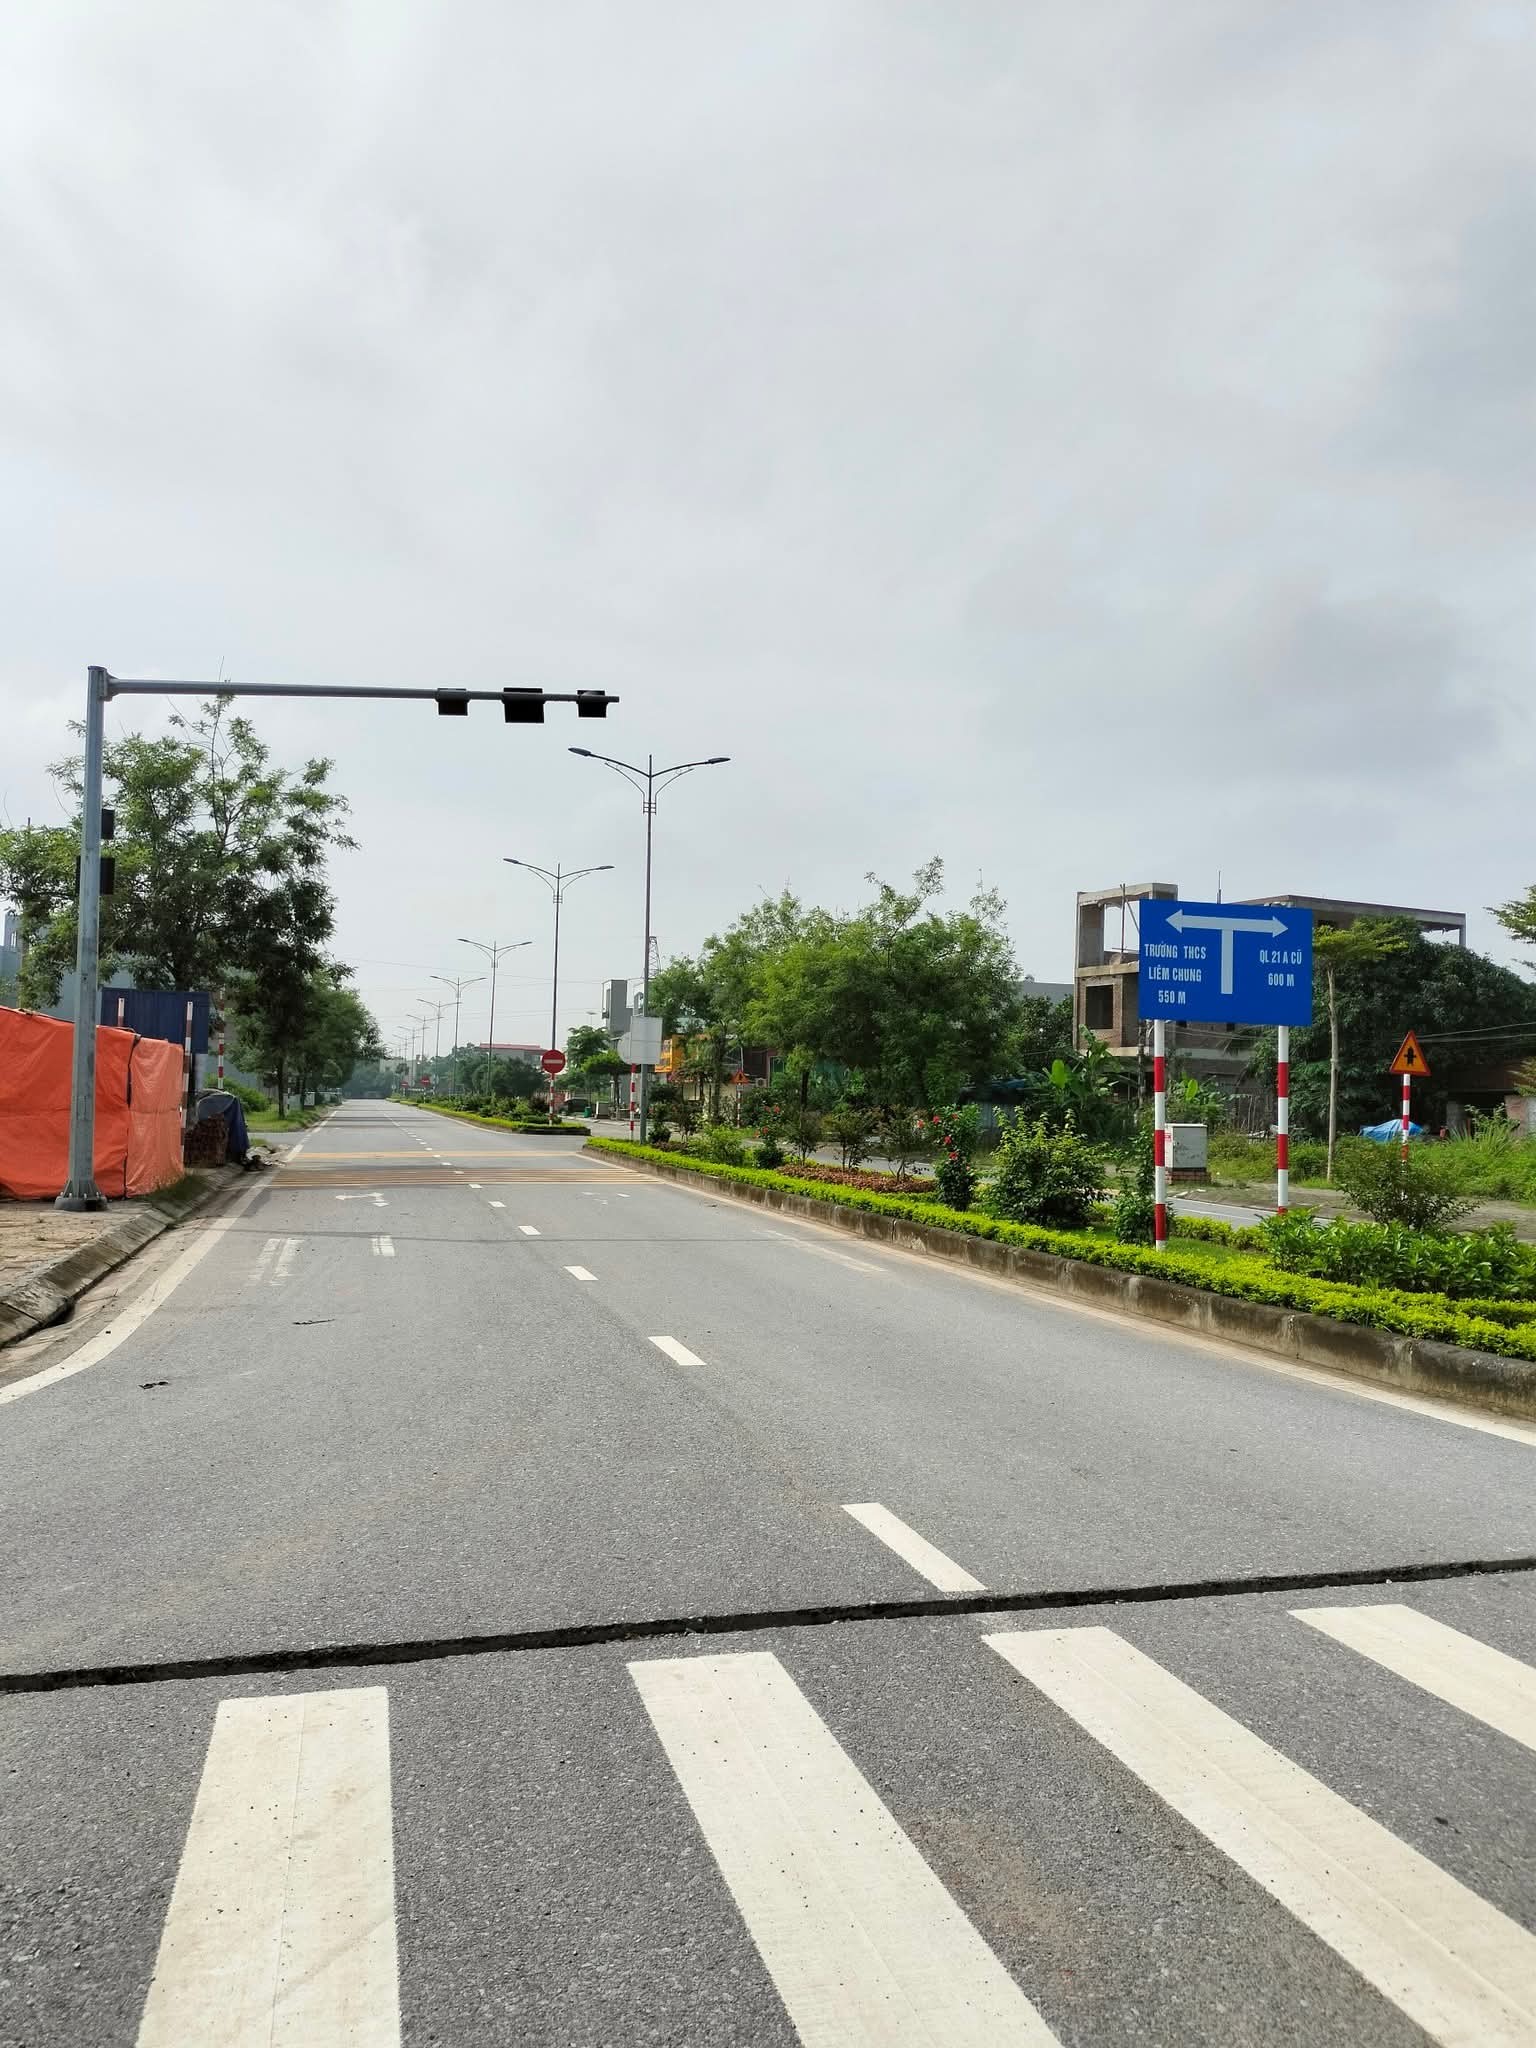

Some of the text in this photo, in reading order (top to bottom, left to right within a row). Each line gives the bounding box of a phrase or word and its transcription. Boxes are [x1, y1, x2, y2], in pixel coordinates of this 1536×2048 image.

[1184, 945, 1207, 960] THCS
[1259, 949, 1269, 964] QL
[1271, 950, 1281, 964] 21
[1282, 951, 1289, 965] A
[1172, 967, 1202, 982] CHUNG
[1268, 972, 1295, 987] 600 M
[1158, 989, 1186, 1004] 550 M
